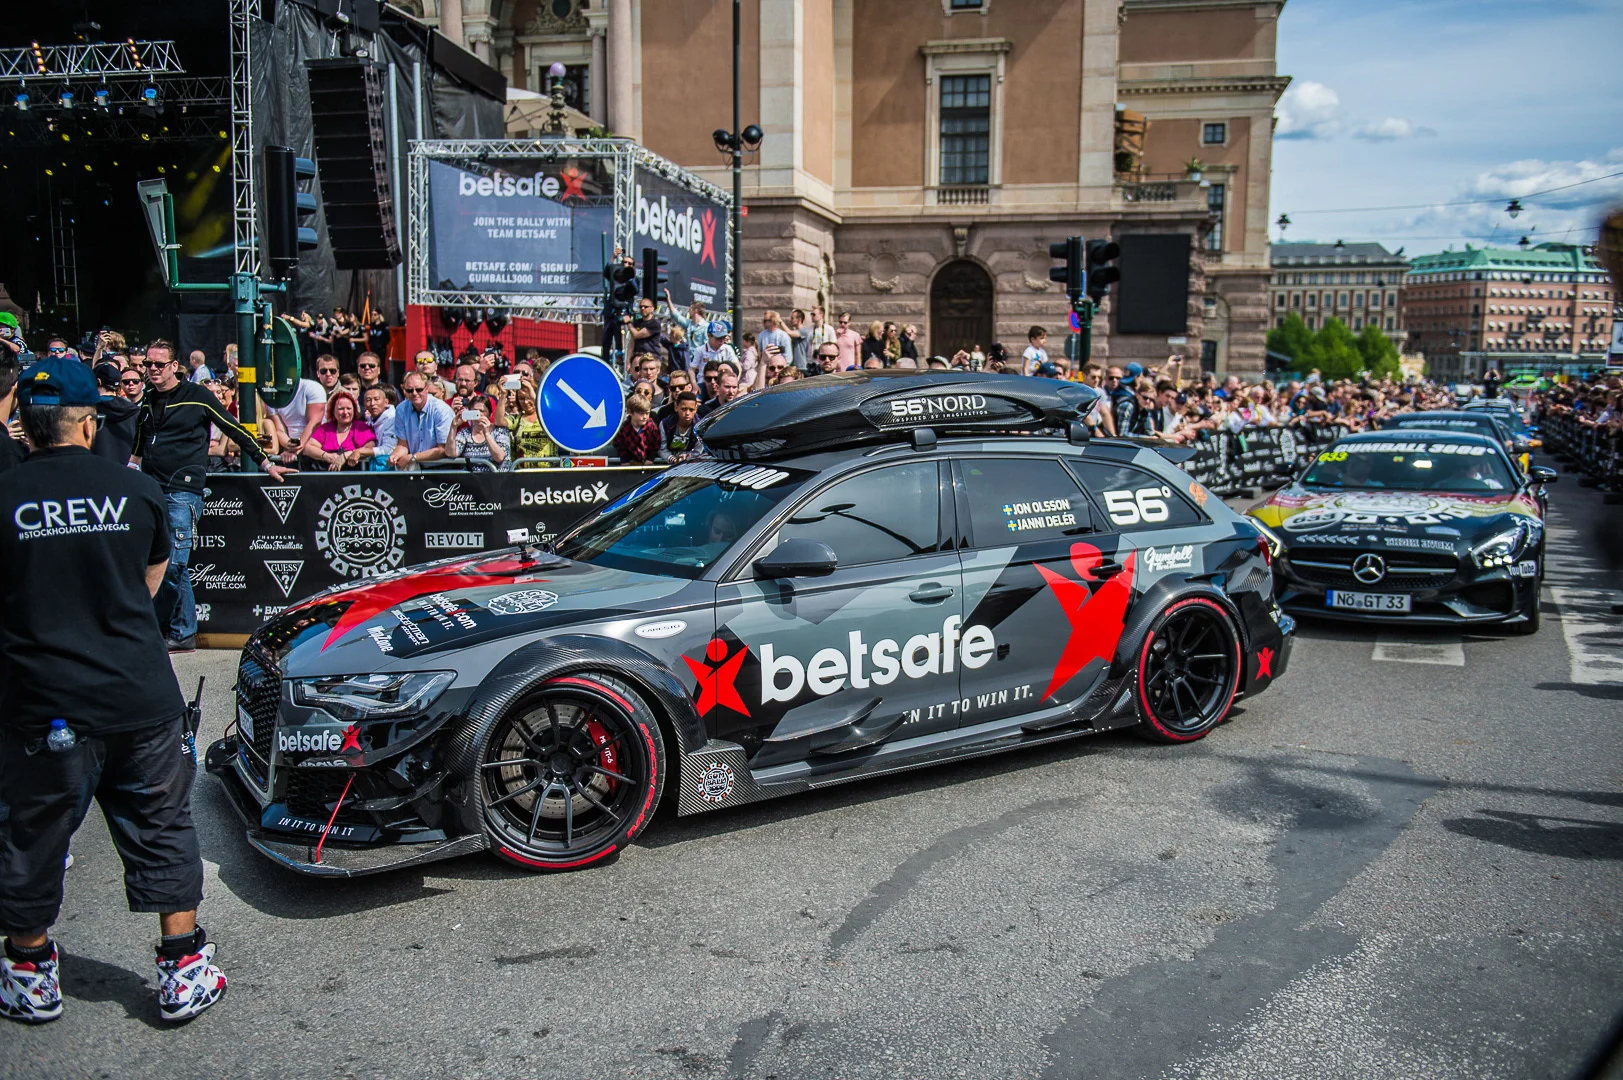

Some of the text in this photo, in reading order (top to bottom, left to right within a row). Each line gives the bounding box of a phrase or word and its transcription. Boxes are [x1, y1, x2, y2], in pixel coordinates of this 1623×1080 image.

[459, 171, 560, 197] betsafe
[473, 216, 571, 227] JOIN THE RALLY WITH
[635, 183, 702, 254] betsafe
[488, 228, 557, 239] TEAM BETSAFE
[540, 262, 579, 272] SIGN UP
[469, 273, 533, 284] GUMBALL3000
[540, 274, 570, 285] HERE!
[1333, 442, 1427, 453] GUMBALL
[268, 489, 295, 498] GUESS
[423, 482, 474, 508] Asian
[520, 485, 593, 506] betsafe
[14, 495, 128, 531] CREW
[202, 508, 244, 516] DATE.COM
[448, 502, 502, 511] DATE.COM
[1012, 499, 1071, 516] JON OLSSON
[1016, 511, 1077, 531] JANNI DELÉR
[18, 523, 131, 541] #STOCKHOLMTOLASVEGAS
[426, 533, 483, 547] REVOLT
[270, 563, 298, 572] GUESS
[1144, 545, 1193, 573] Gumball
[1337, 592, 1404, 609] NÖ GT 33
[759, 614, 995, 705] betsafe
[927, 703, 945, 720] IT
[951, 698, 970, 714] TO
[976, 689, 1008, 709] WIN
[1013, 684, 1033, 701] IT.
[277, 729, 342, 752] betsafe
[278, 817, 292, 826] IN
[291, 819, 304, 829] IT
[304, 822, 316, 832] TO
[341, 827, 355, 836] IT
